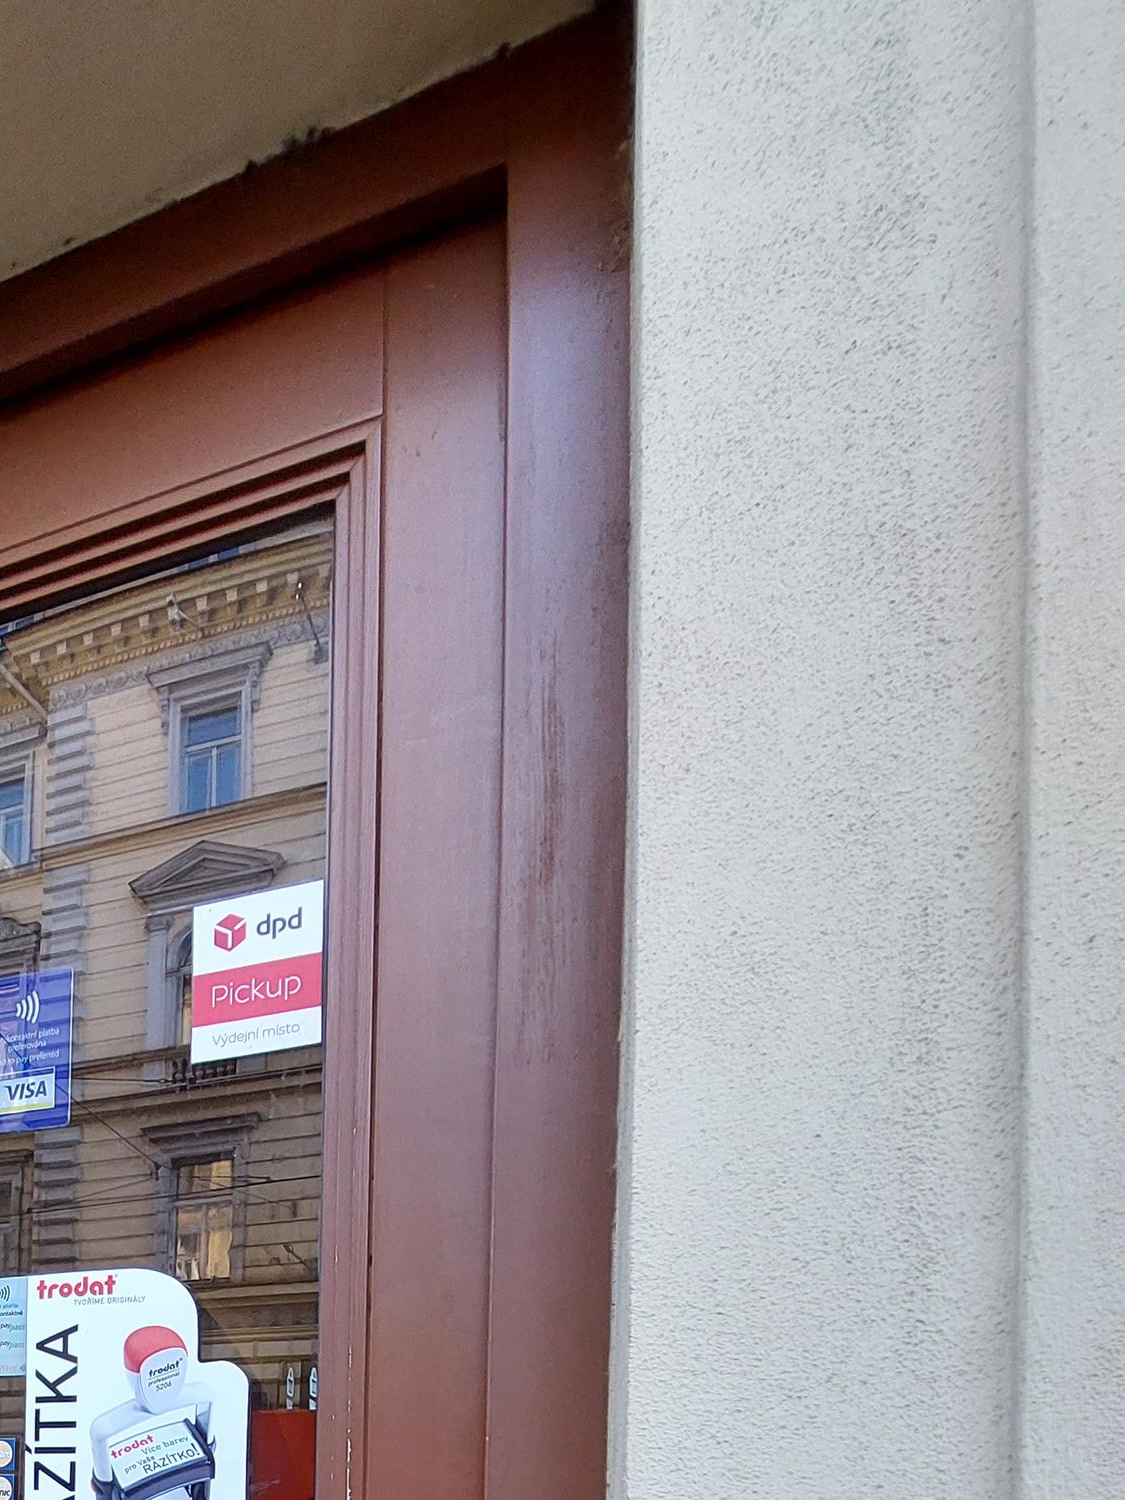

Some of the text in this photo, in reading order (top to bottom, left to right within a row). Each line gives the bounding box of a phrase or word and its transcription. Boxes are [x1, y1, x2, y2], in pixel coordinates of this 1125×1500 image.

[256, 906, 303, 939] dpd
[211, 975, 302, 1008] Pickup
[212, 1023, 301, 1048] Výdejní místo
[4, 1080, 48, 1100] VISA
[36, 1275, 116, 1300] trodat
[148, 1360, 180, 1377] trodat
[110, 1434, 154, 1459] trodat
[163, 1435, 189, 1448] barev
[124, 1454, 156, 1474] pro Vaše
[142, 1442, 201, 1475] RAZÍTKO!
